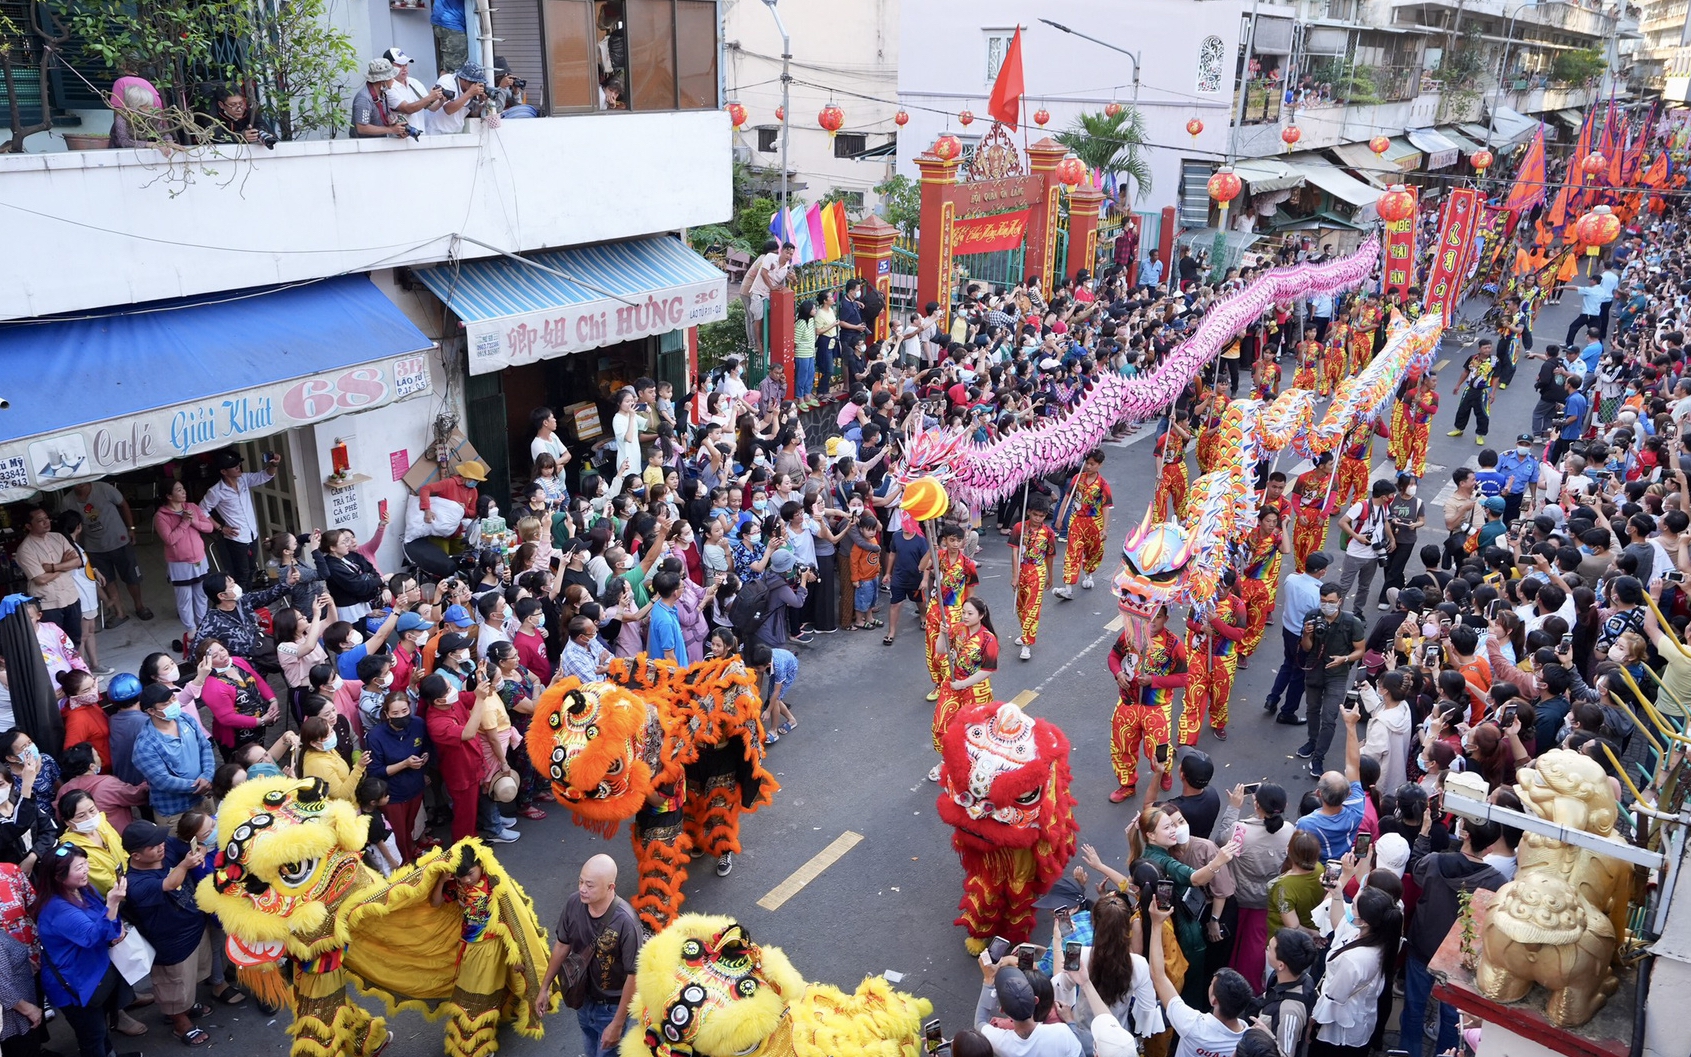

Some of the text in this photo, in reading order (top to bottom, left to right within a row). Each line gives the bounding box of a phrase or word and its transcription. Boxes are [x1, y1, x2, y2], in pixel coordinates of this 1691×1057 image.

[879, 260, 888, 270] 5
[694, 288, 718, 304] 3C
[93, 367, 388, 467] Café Giải Khát 68
